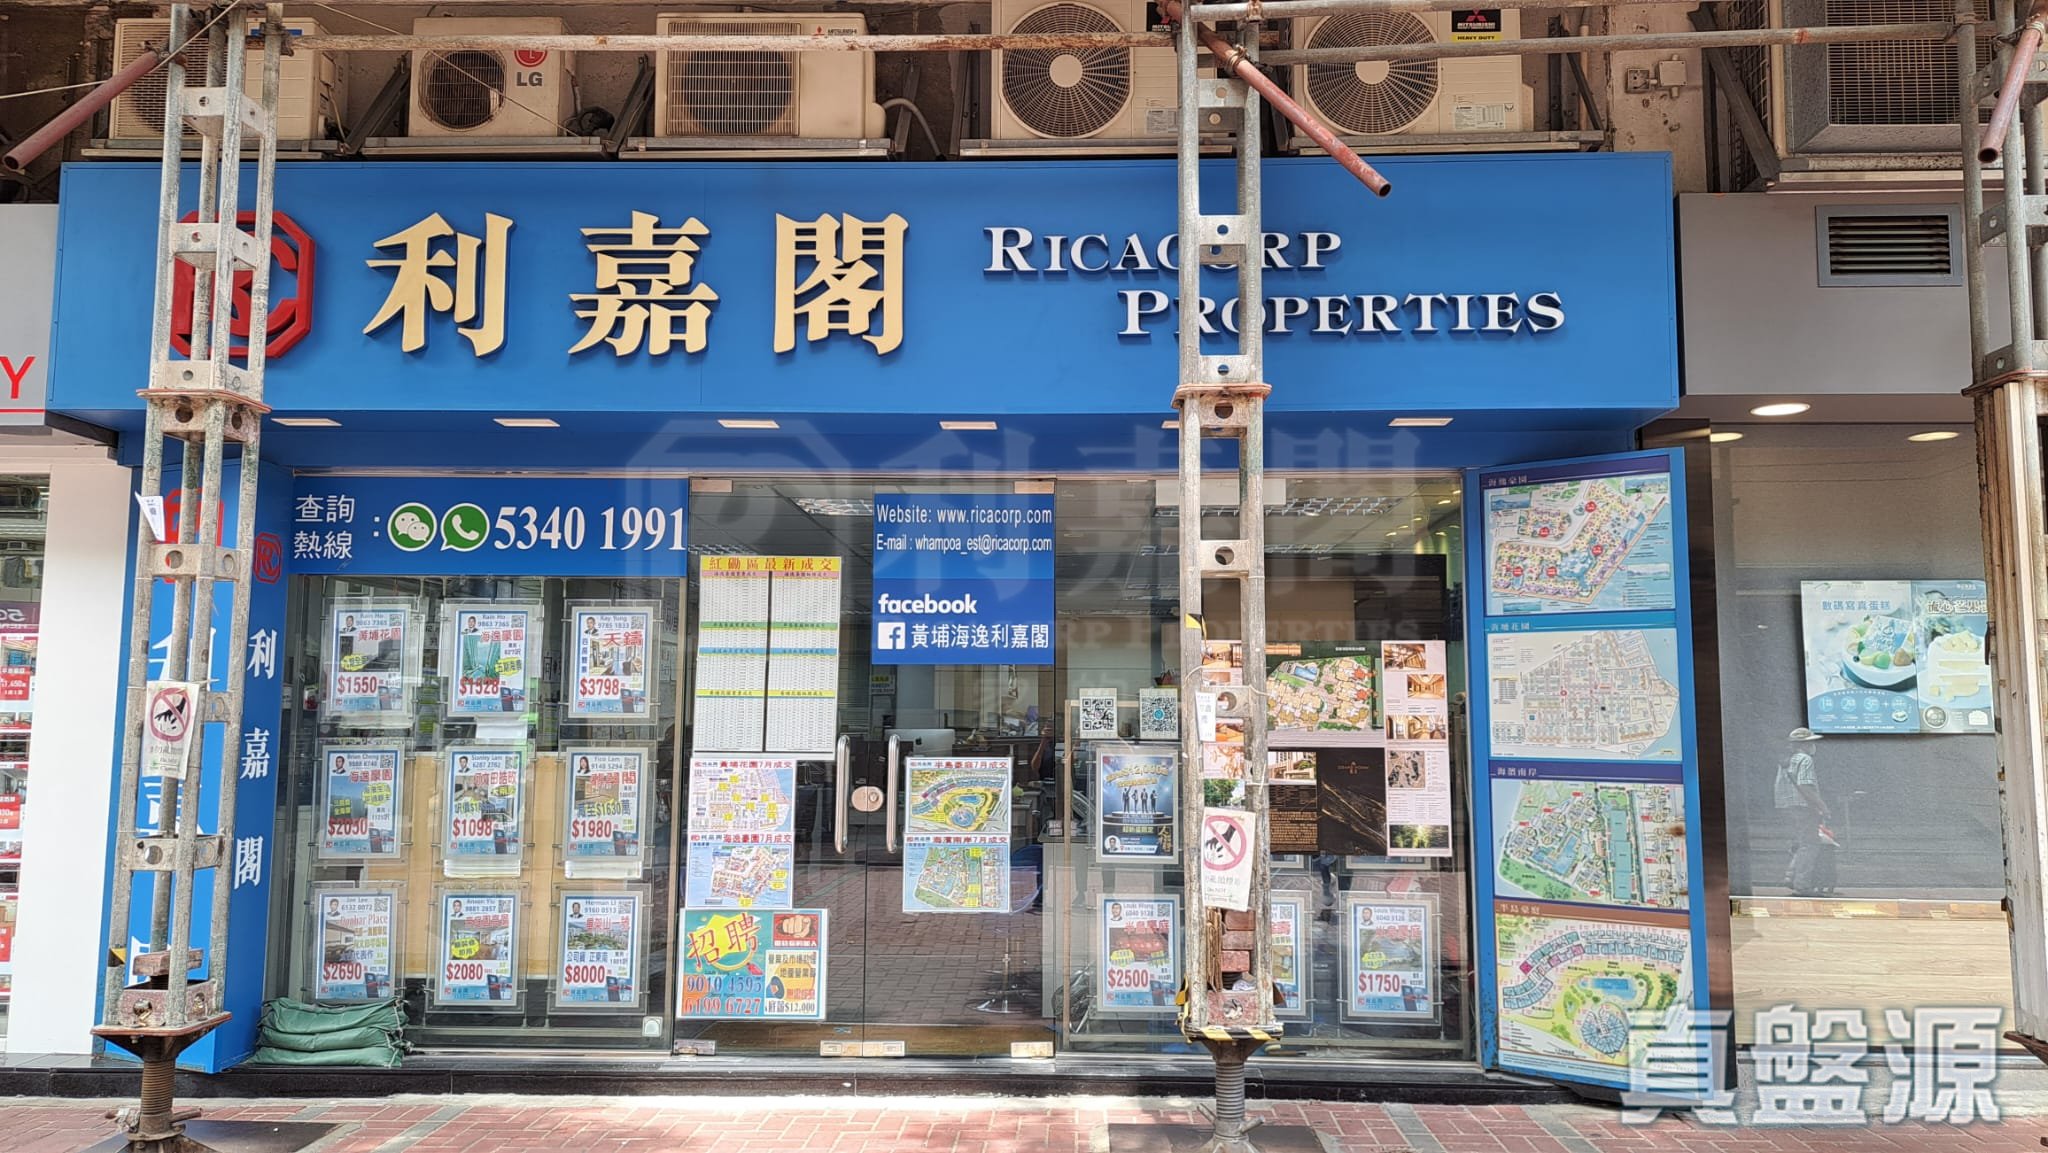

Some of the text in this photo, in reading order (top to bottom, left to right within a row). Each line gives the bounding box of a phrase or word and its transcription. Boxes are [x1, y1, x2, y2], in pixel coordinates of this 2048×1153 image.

[516, 71, 543, 87] LG
[983, 227, 1341, 272] RICACRP
[363, 210, 908, 356] 利嘉閣
[295, 494, 356, 524] 查詢
[877, 504, 1052, 528] Website: www.ricacorp.com
[494, 506, 585, 551] 5340
[600, 506, 686, 551] 1991
[294, 530, 353, 560] 熱線
[877, 533, 907, 551] E-mail
[915, 534, 1052, 556] whampoa_est@ricacorp.com
[878, 593, 977, 614] facebook
[1822, 599, 1890, 611] 數碼寫真蛋糕
[602, 631, 643, 647] 天鑄
[911, 623, 1049, 649] 黃埔海逸利嘉閣
[337, 675, 377, 694] $1550
[459, 677, 499, 696] $1528
[579, 677, 620, 697] $3798
[235, 628, 278, 890] 利嘉閣
[328, 817, 368, 836] $2050
[452, 817, 493, 838] $1098
[571, 819, 612, 840] $1980
[368, 913, 388, 925] Place
[688, 912, 761, 968] 招聘
[323, 961, 362, 982] $2690
[446, 962, 483, 981] $2080
[565, 964, 606, 984] $8000
[1107, 968, 1149, 989] $2500
[687, 976, 762, 993] 9010 4595
[1358, 973, 1400, 993] $1750
[685, 997, 761, 1014] 6199 6727
